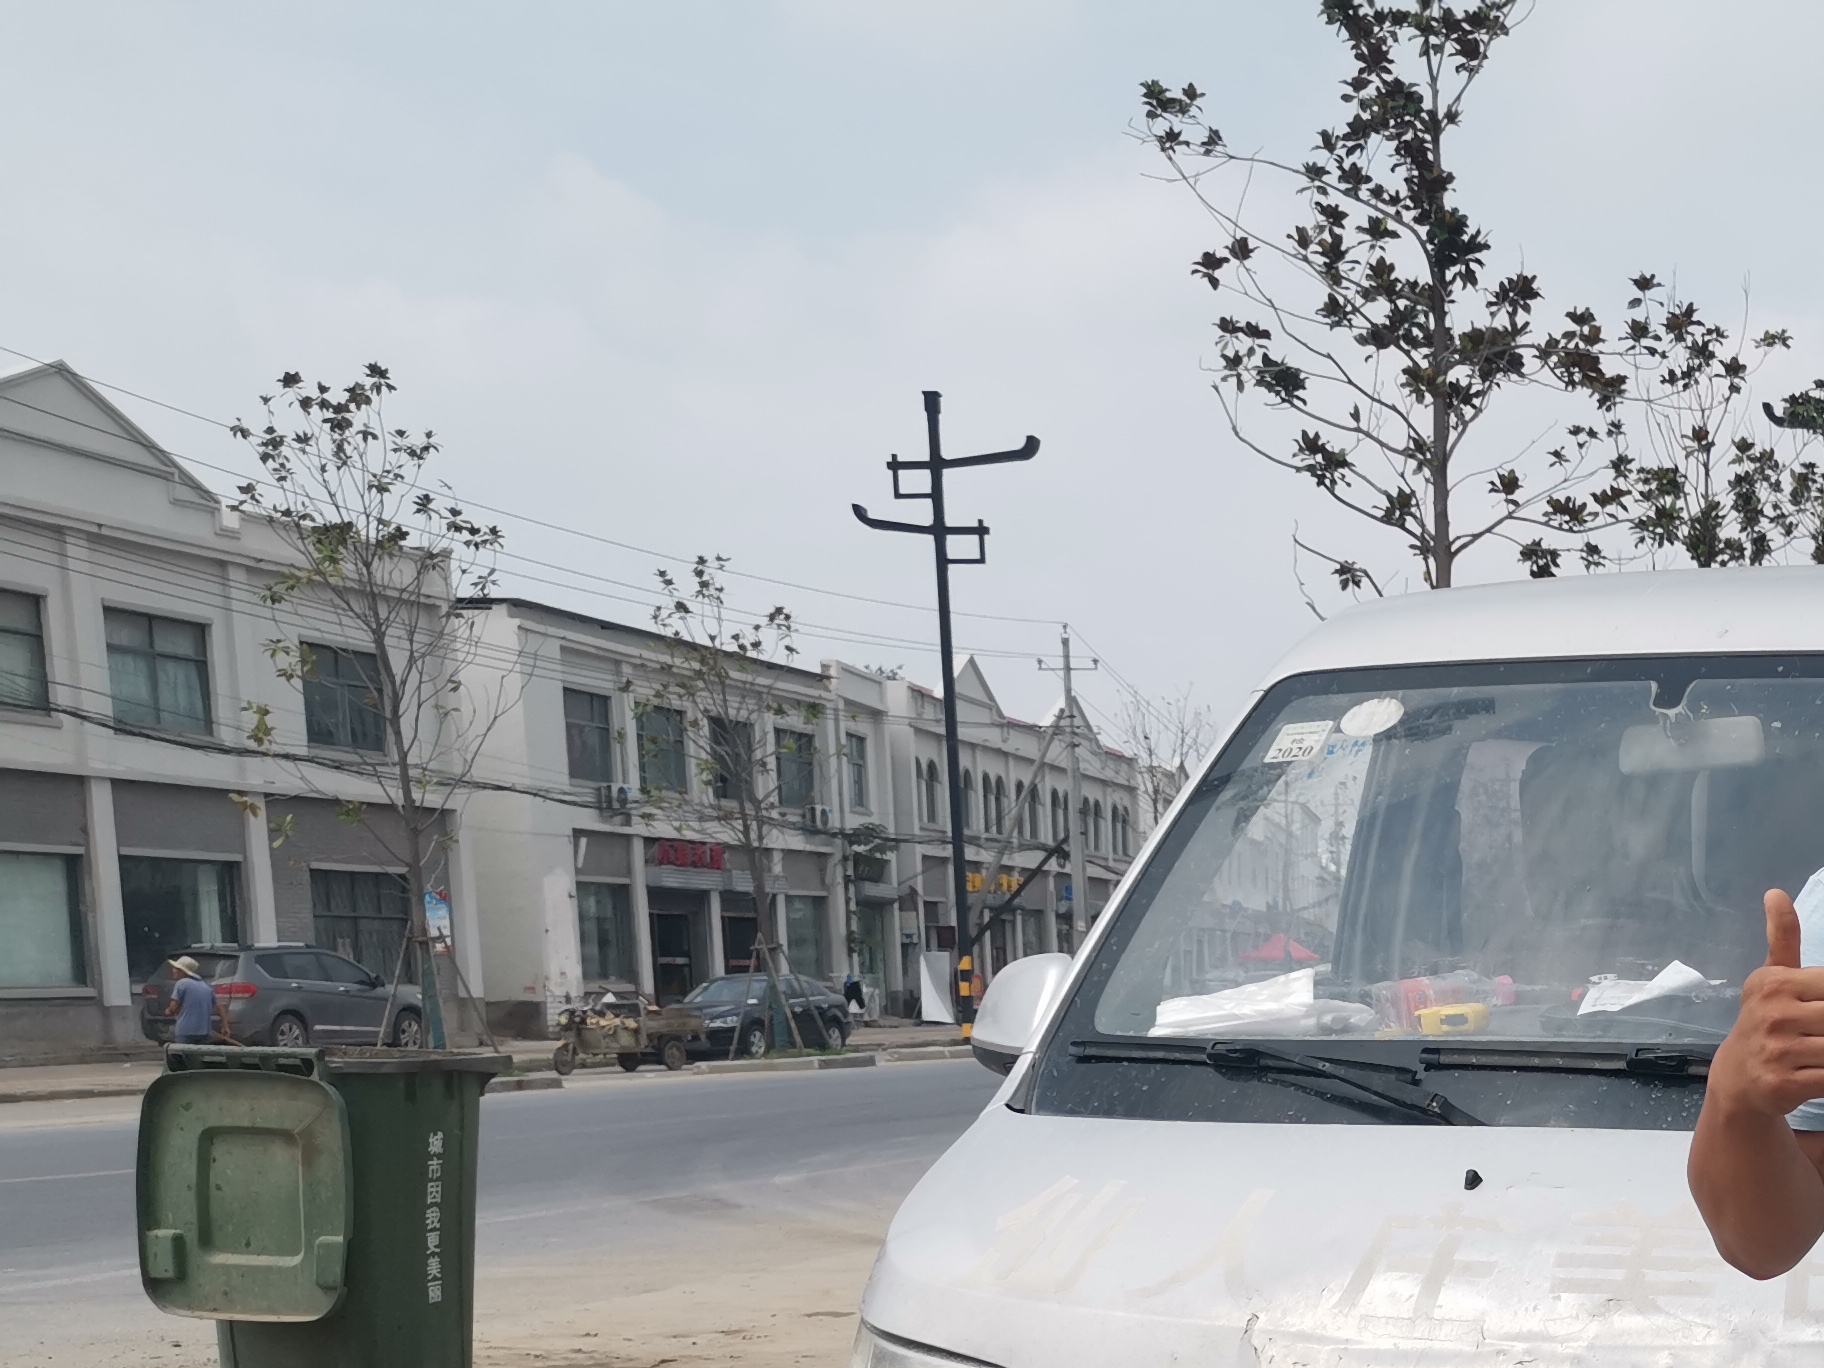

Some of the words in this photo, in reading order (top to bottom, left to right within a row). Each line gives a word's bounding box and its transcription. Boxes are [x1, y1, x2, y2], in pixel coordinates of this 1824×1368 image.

[1270, 745, 1314, 760] 2020
[424, 1130, 445, 1305] 城市因我更美丽
